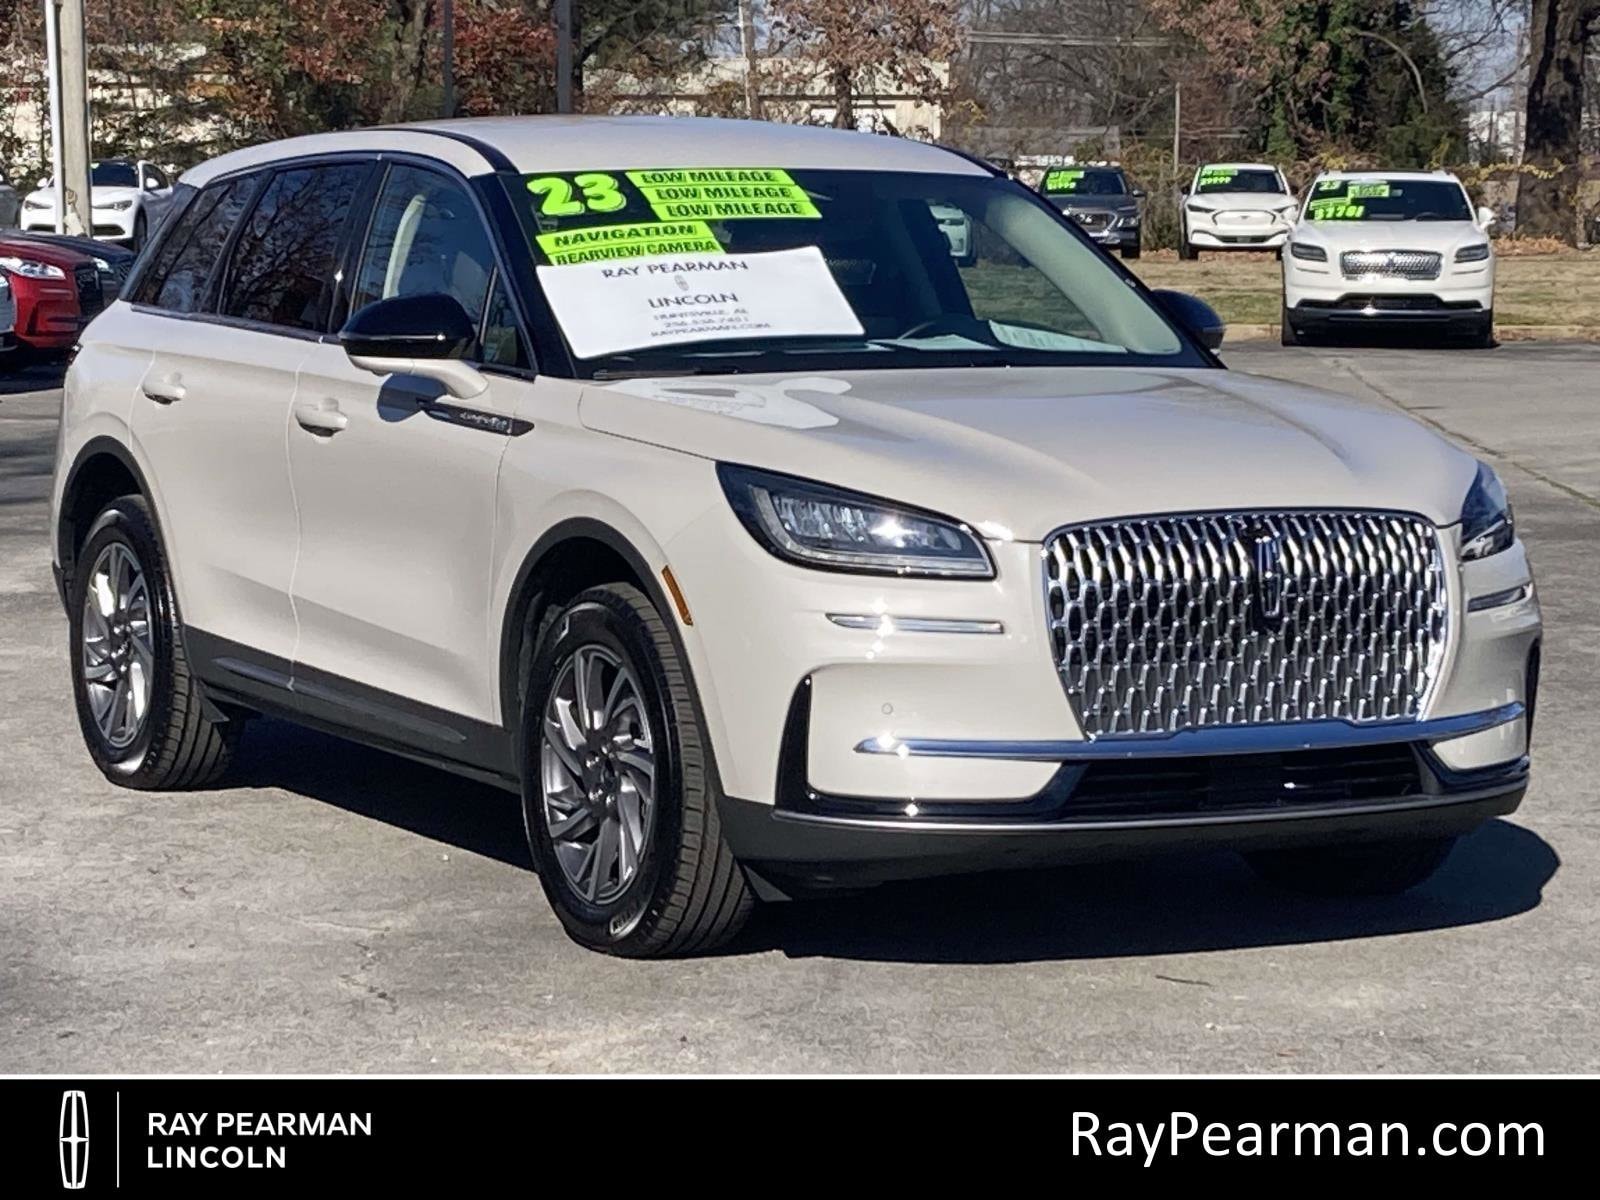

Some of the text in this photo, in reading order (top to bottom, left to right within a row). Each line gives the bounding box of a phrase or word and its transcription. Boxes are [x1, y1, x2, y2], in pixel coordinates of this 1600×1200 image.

[640, 170, 777, 184] LOW MILEAGE
[526, 173, 627, 216] 23
[655, 186, 794, 200] LOW MILEAGE
[665, 202, 804, 217] LOW MILEAGE
[553, 225, 695, 248] NAVIGATION
[555, 240, 717, 265] REARVIEW CAMERA
[601, 260, 750, 279] RAY PEARMAN
[647, 292, 739, 309] LINCOLN
